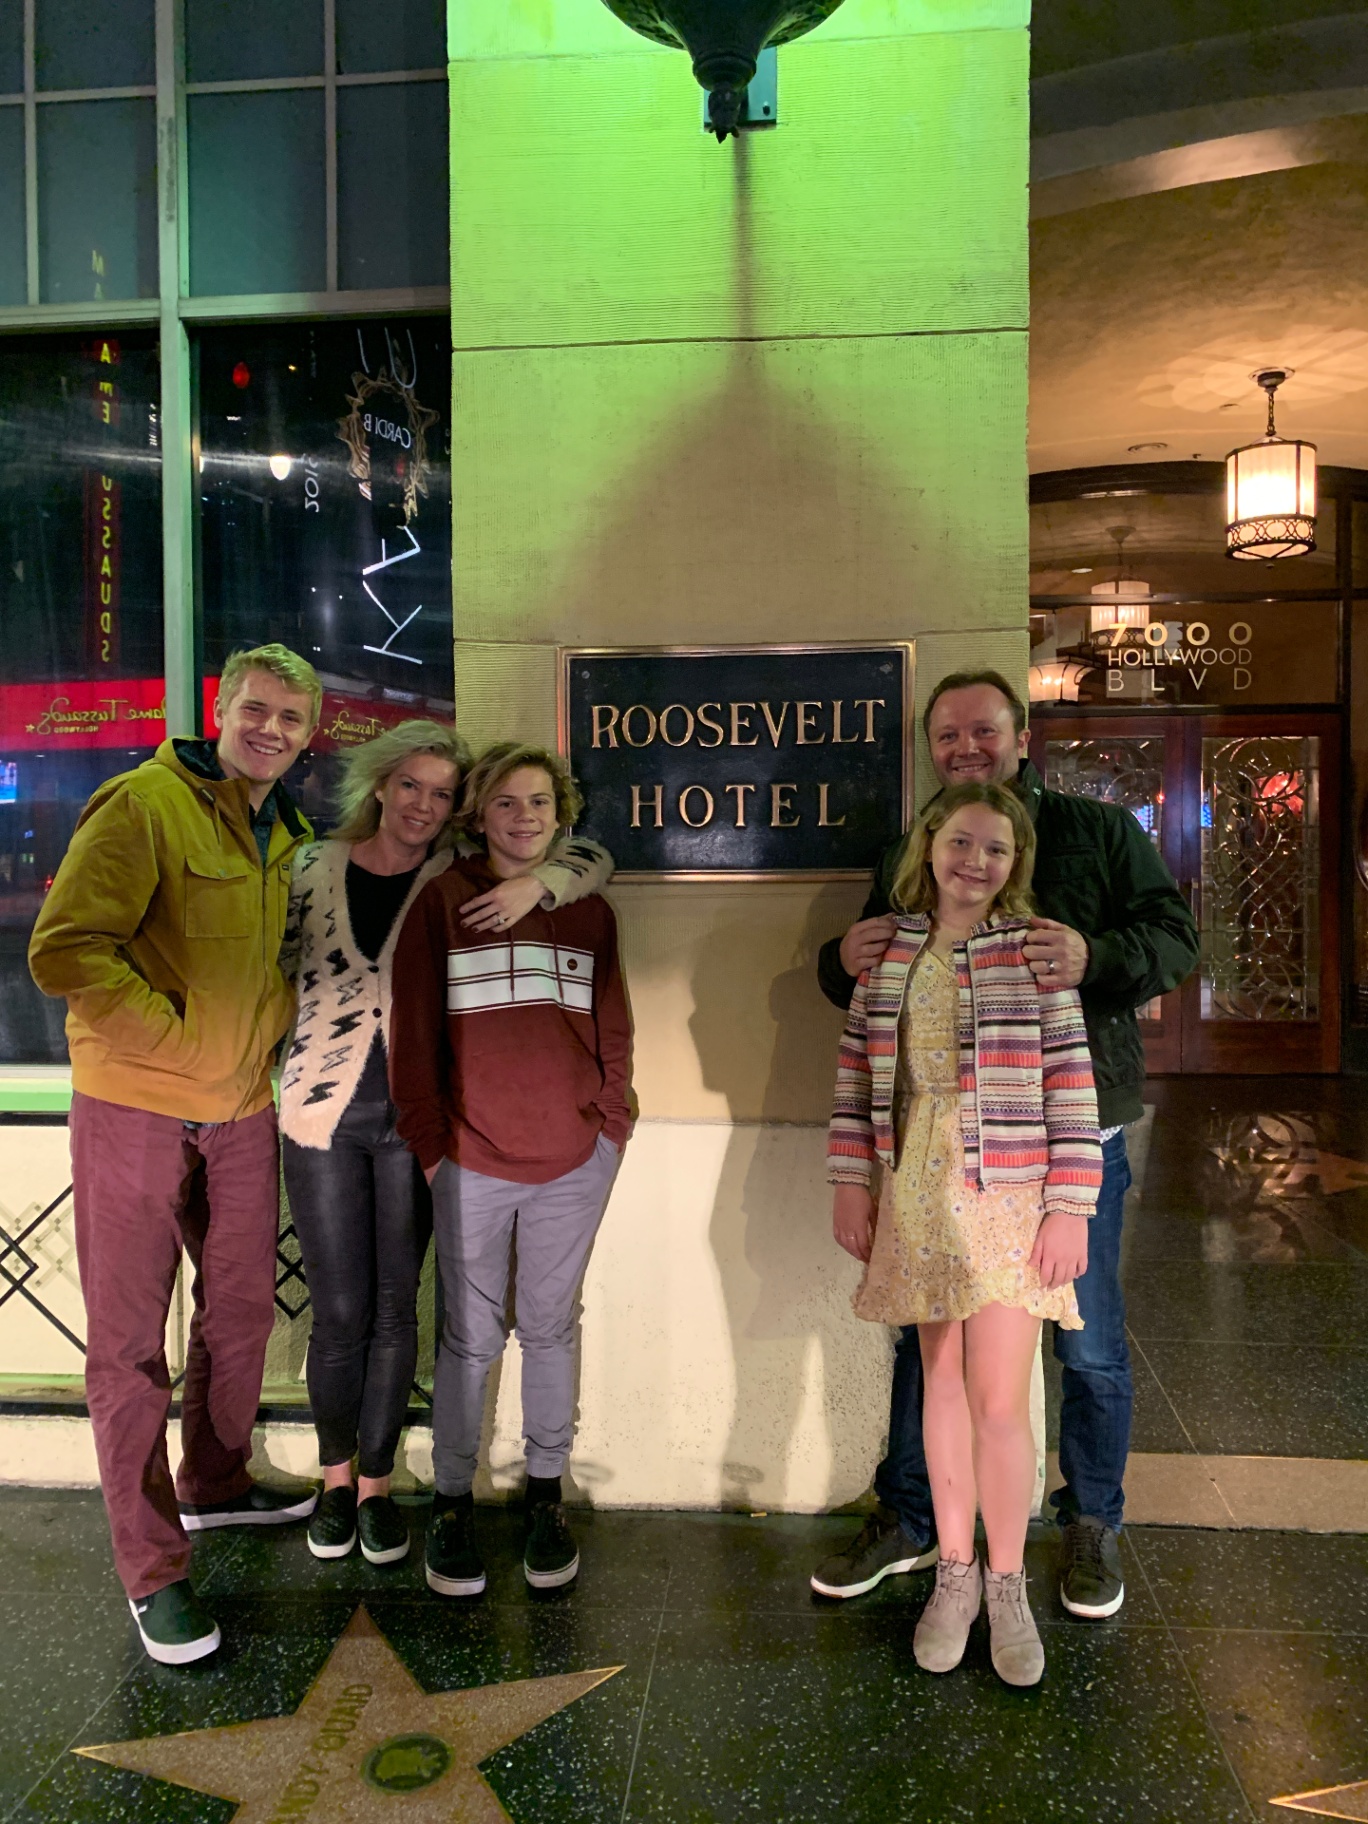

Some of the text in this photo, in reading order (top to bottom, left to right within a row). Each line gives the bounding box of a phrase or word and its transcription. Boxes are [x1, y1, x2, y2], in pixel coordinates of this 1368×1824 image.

[1108, 621, 1253, 647] 7000
[1108, 648, 1253, 666] HOLLYWOOD
[1108, 667, 1252, 692] BLVD
[591, 699, 885, 748] ROOSEVELT
[630, 783, 846, 828] HOTEL
